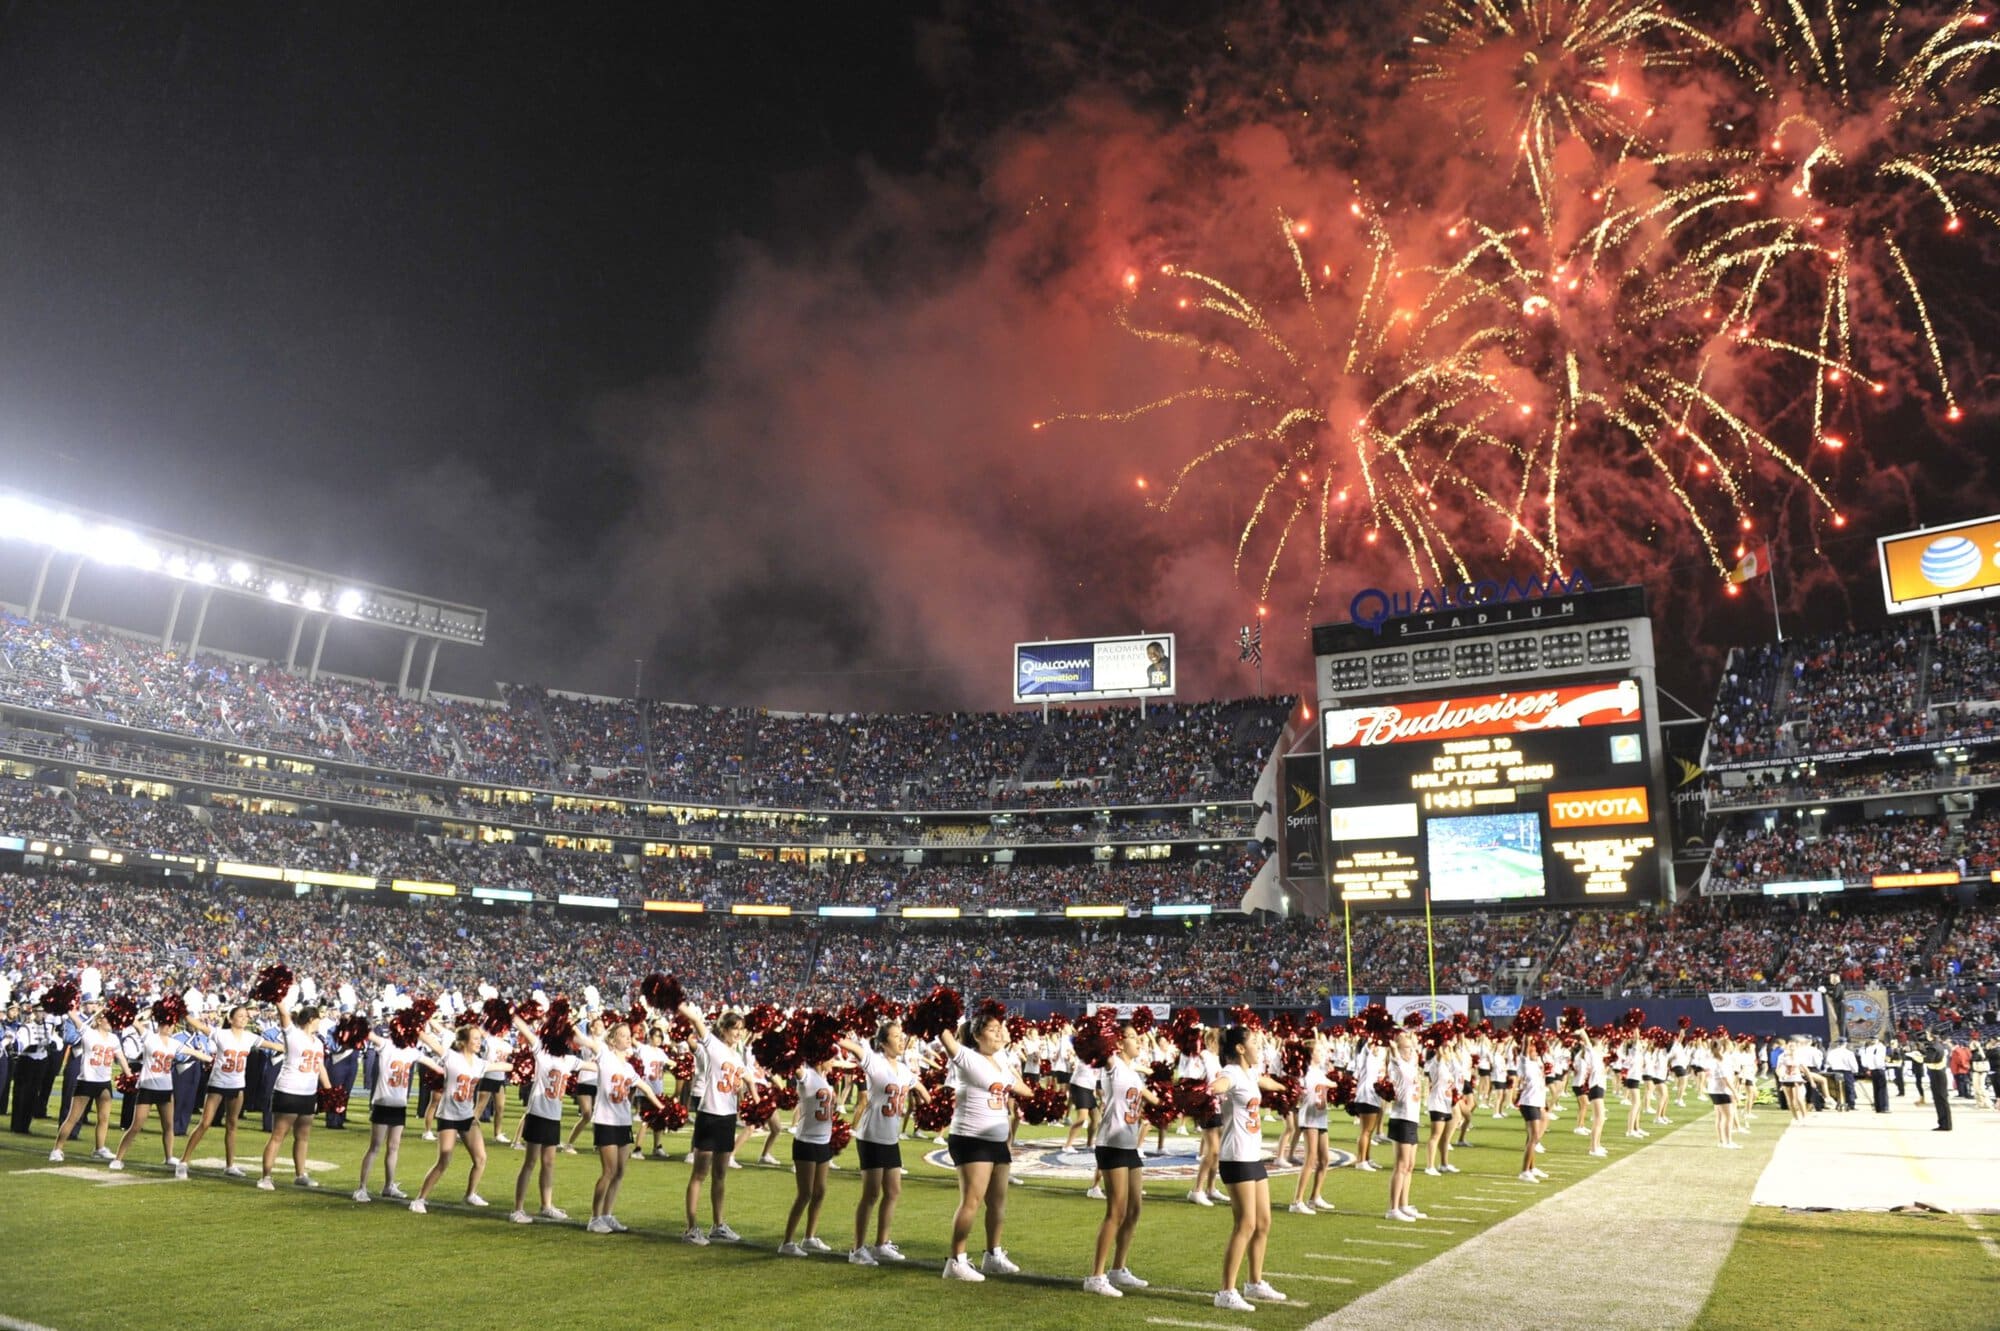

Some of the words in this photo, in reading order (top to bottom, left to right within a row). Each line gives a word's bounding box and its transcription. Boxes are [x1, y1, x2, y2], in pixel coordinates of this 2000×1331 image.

[1350, 568, 1593, 635] QUALCOMM
[1400, 602, 1575, 634] STADIUM
[1021, 659, 1091, 676] QUALCOMM
[1355, 692, 1559, 746] Budweiser
[1552, 797, 1644, 819] TOYOTA
[1287, 815, 1319, 829] Sprint
[1790, 994, 1814, 1014] N
